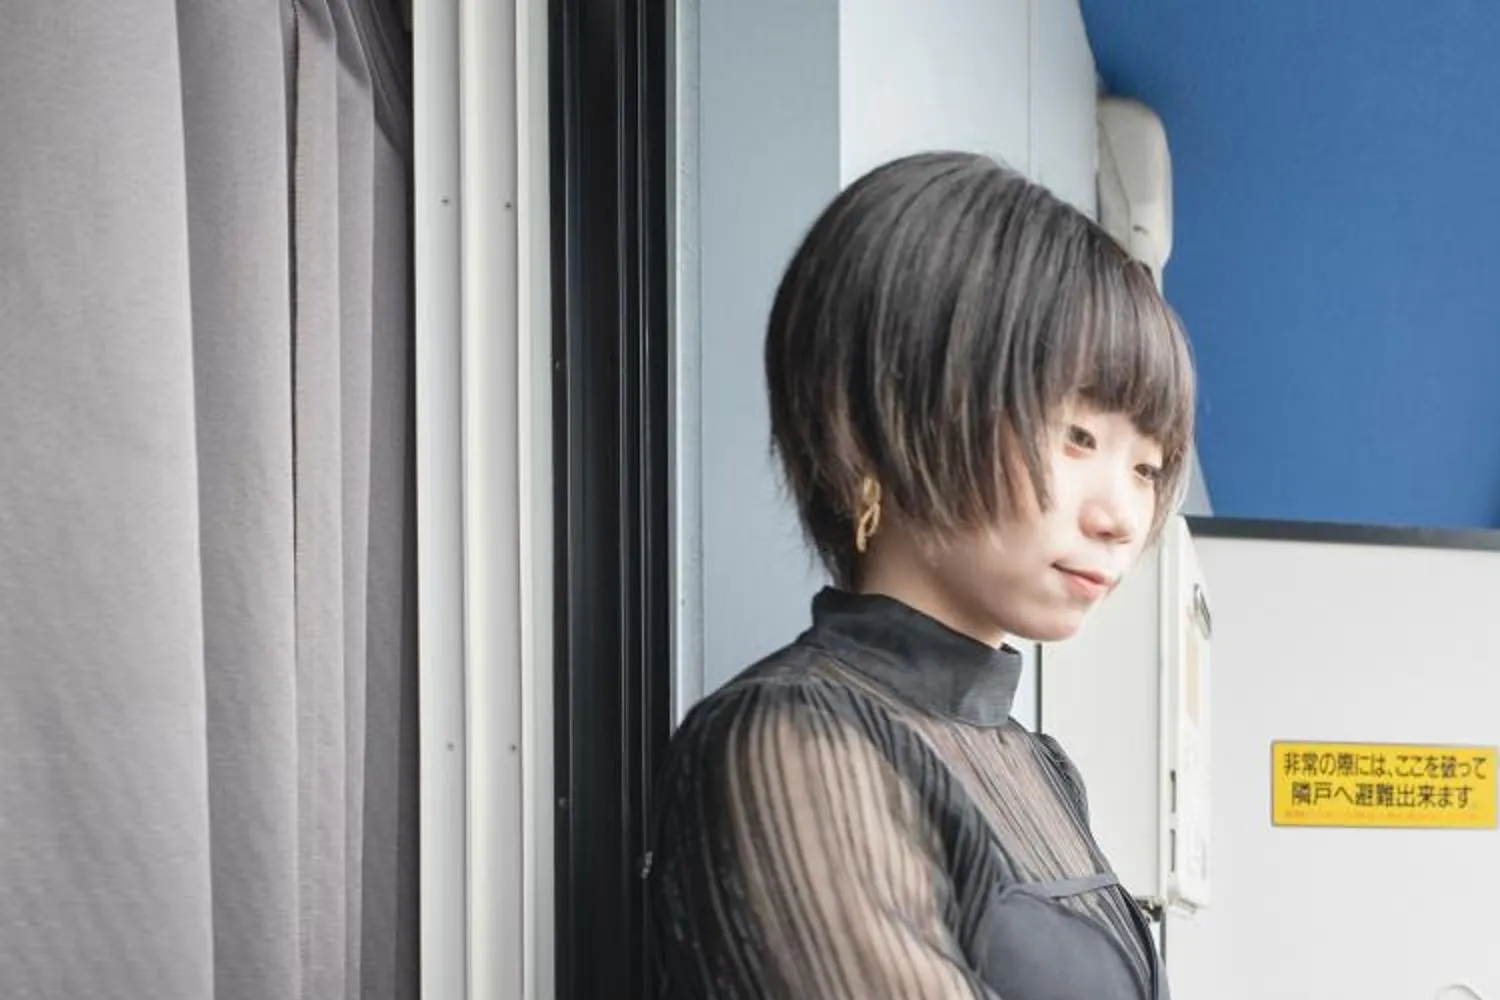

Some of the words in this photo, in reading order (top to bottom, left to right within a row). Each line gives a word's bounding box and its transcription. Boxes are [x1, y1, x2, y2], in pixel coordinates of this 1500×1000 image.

[1284, 751, 1487, 780] 非常の際には、ここを破って
